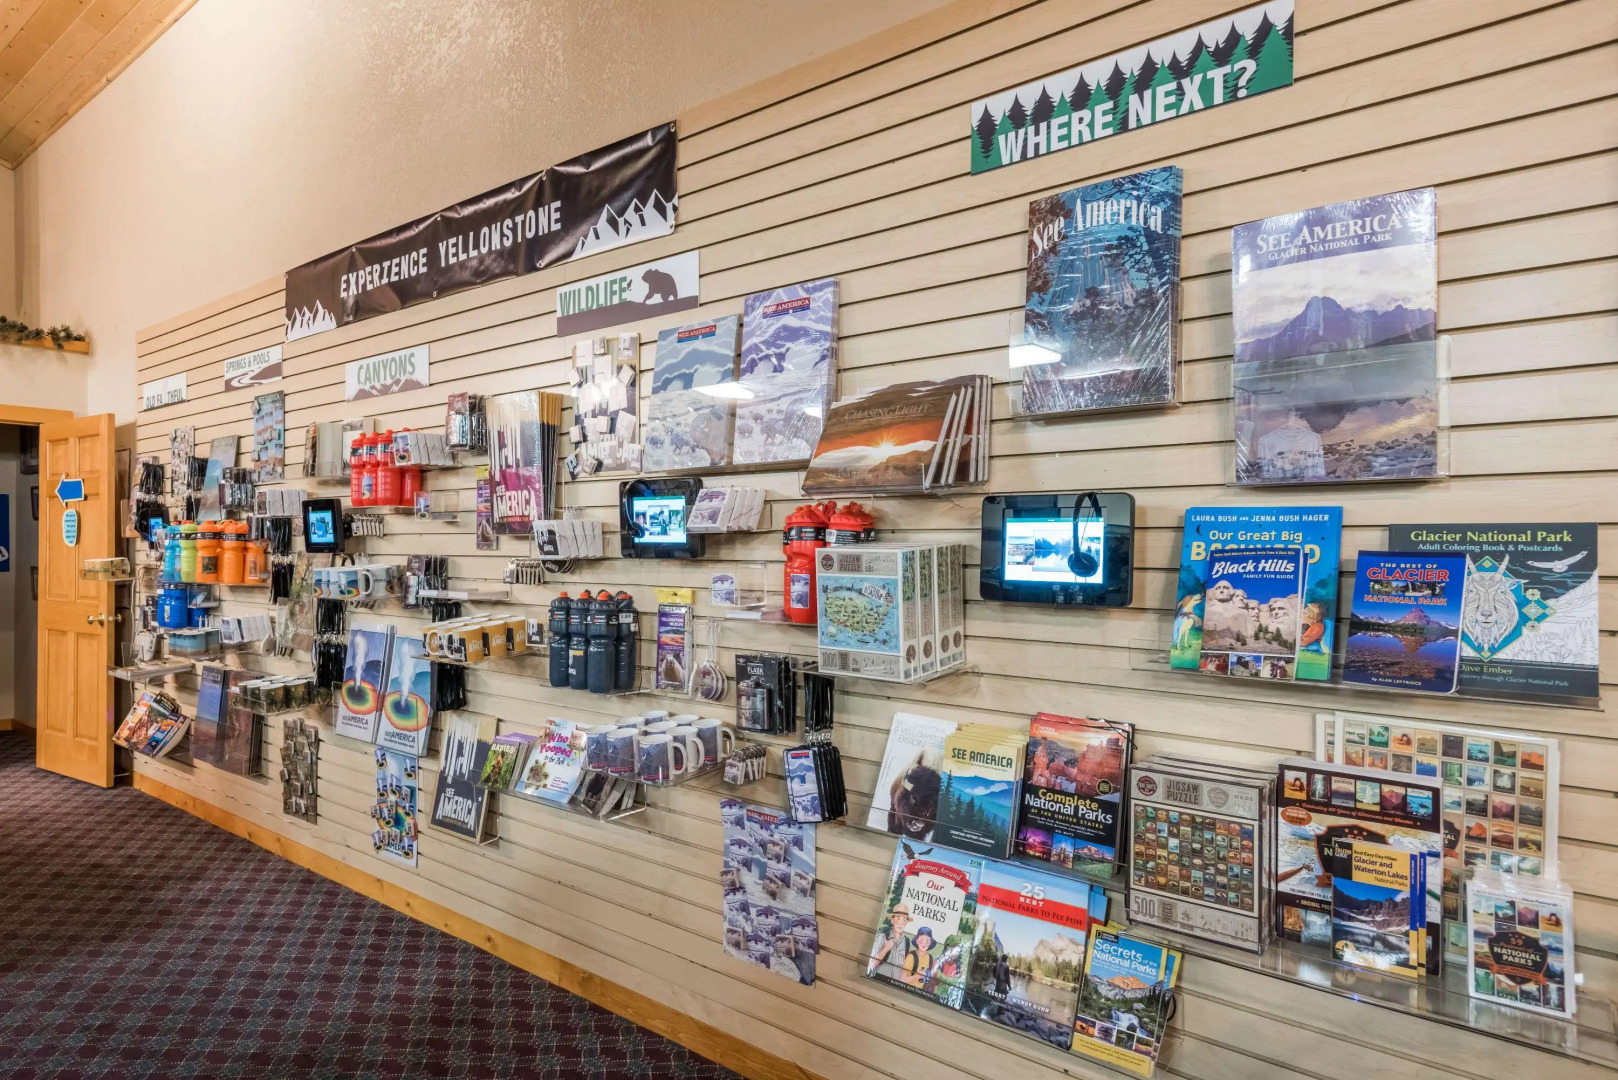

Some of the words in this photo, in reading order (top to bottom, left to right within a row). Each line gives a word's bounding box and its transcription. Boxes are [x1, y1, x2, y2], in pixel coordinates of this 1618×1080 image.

[998, 101, 1113, 166] WHERE
[1128, 59, 1256, 130] NEXT?
[1032, 216, 1065, 261] See
[1069, 190, 1163, 234] America
[1256, 232, 1291, 254] SEE
[1298, 212, 1402, 245] AMERICA
[340, 248, 428, 298] EXPERIENCE
[439, 200, 561, 267] YELLOWSTONE
[1268, 247, 1306, 261] GLACIER
[1310, 238, 1360, 253] NATIONAL
[1363, 232, 1392, 244] PARK
[559, 276, 628, 316] WILDLIFE
[777, 299, 810, 311] AMERICA
[226, 356, 247, 373] SPRINGS
[253, 351, 270, 366] POOLS
[357, 352, 415, 385] CANYONS
[146, 395, 156, 408] OLD
[845, 407, 892, 420] CHASING
[896, 403, 929, 416] LIGHT
[496, 485, 506, 496] SEE
[493, 490, 538, 523] AMERICA
[1191, 514, 1215, 522] LAURA
[1209, 530, 1233, 541] Our
[1237, 530, 1277, 541] Great
[1281, 530, 1303, 543] Big
[1410, 530, 1462, 542] Glacier
[1466, 530, 1532, 542] National
[1537, 531, 1573, 542] Park
[1442, 543, 1481, 552] Coloring
[1483, 543, 1506, 551] Book
[1517, 544, 1563, 552] Postcards
[840, 563, 861, 572] PUZZLE
[1212, 560, 1257, 578] Black
[1257, 559, 1295, 572] Hills
[1367, 568, 1449, 581] GLACIER
[1364, 595, 1417, 604] NATIONAL
[1418, 597, 1448, 606] PARK
[822, 652, 837, 668] 1000
[747, 666, 764, 674] FLASK
[1483, 666, 1513, 675] Ember
[1528, 678, 1553, 686] National
[391, 730, 416, 744] AMERICA
[549, 733, 569, 743] Who
[540, 744, 573, 758] Pooped
[952, 747, 967, 760] SEE
[969, 751, 1013, 769] AMERICA
[445, 788, 455, 797] SEE
[1167, 780, 1199, 793] JIGSAW
[1038, 789, 1099, 811] Complete
[1167, 790, 1199, 805] PUZZLE
[436, 793, 477, 831] AMERICA
[1025, 793, 1074, 815] National
[1078, 805, 1113, 824] Parks
[1054, 813, 1077, 823] UNITED
[1080, 819, 1103, 829] STATES
[1354, 856, 1377, 867] Glacier
[1378, 860, 1393, 869] and
[1363, 851, 1374, 859] Easy
[915, 862, 938, 872] Journey
[939, 868, 962, 880] Around
[1354, 864, 1386, 876] Waterton
[1387, 870, 1408, 881] Lakes
[926, 879, 944, 891] Our
[1374, 876, 1393, 885] National
[1394, 880, 1408, 888] Parks
[1020, 882, 1045, 900] 25
[906, 888, 959, 912] NATIONAL
[1020, 896, 1044, 907] BEST
[1134, 895, 1155, 919] 500
[912, 904, 947, 922] PARKS
[982, 895, 1016, 909] NATIONAL
[1017, 904, 1038, 916] PARKS
[1040, 909, 1050, 918] TO
[1052, 911, 1064, 920] FLY
[1066, 915, 1082, 926] FISH
[1510, 937, 1523, 946] 59
[1095, 940, 1142, 962] Secrets
[1494, 946, 1541, 961] NATIONAL
[1093, 951, 1130, 967] National
[1132, 960, 1156, 976] Parks
[1503, 956, 1532, 966] PARKS
[987, 990, 1006, 999] TERRY
[1012, 998, 1032, 1009] WENDY
[1033, 1003, 1050, 1013] GUNN
